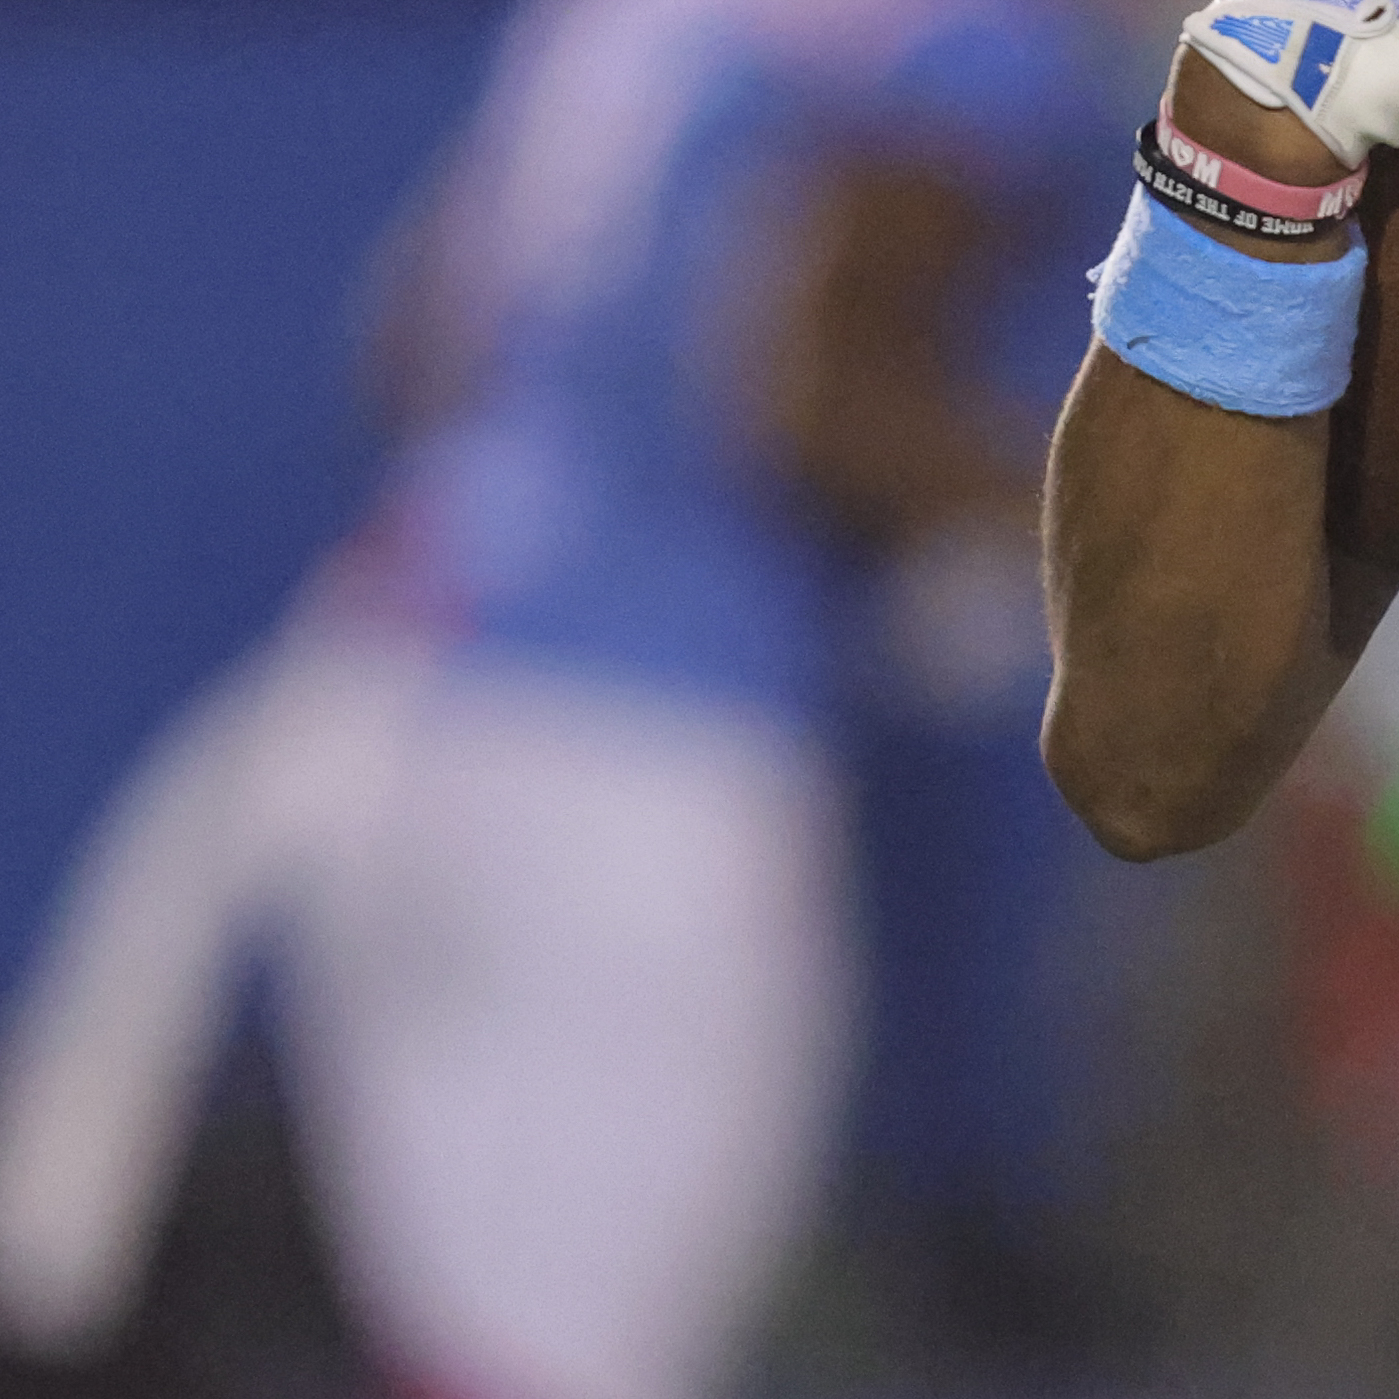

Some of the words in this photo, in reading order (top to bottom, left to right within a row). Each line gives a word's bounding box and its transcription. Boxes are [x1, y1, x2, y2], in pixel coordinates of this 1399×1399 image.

[1153, 171, 1194, 205] 12TH
[1195, 193, 1231, 221] THE
[1233, 210, 1258, 230] OF
[1260, 216, 1315, 235] HOME
